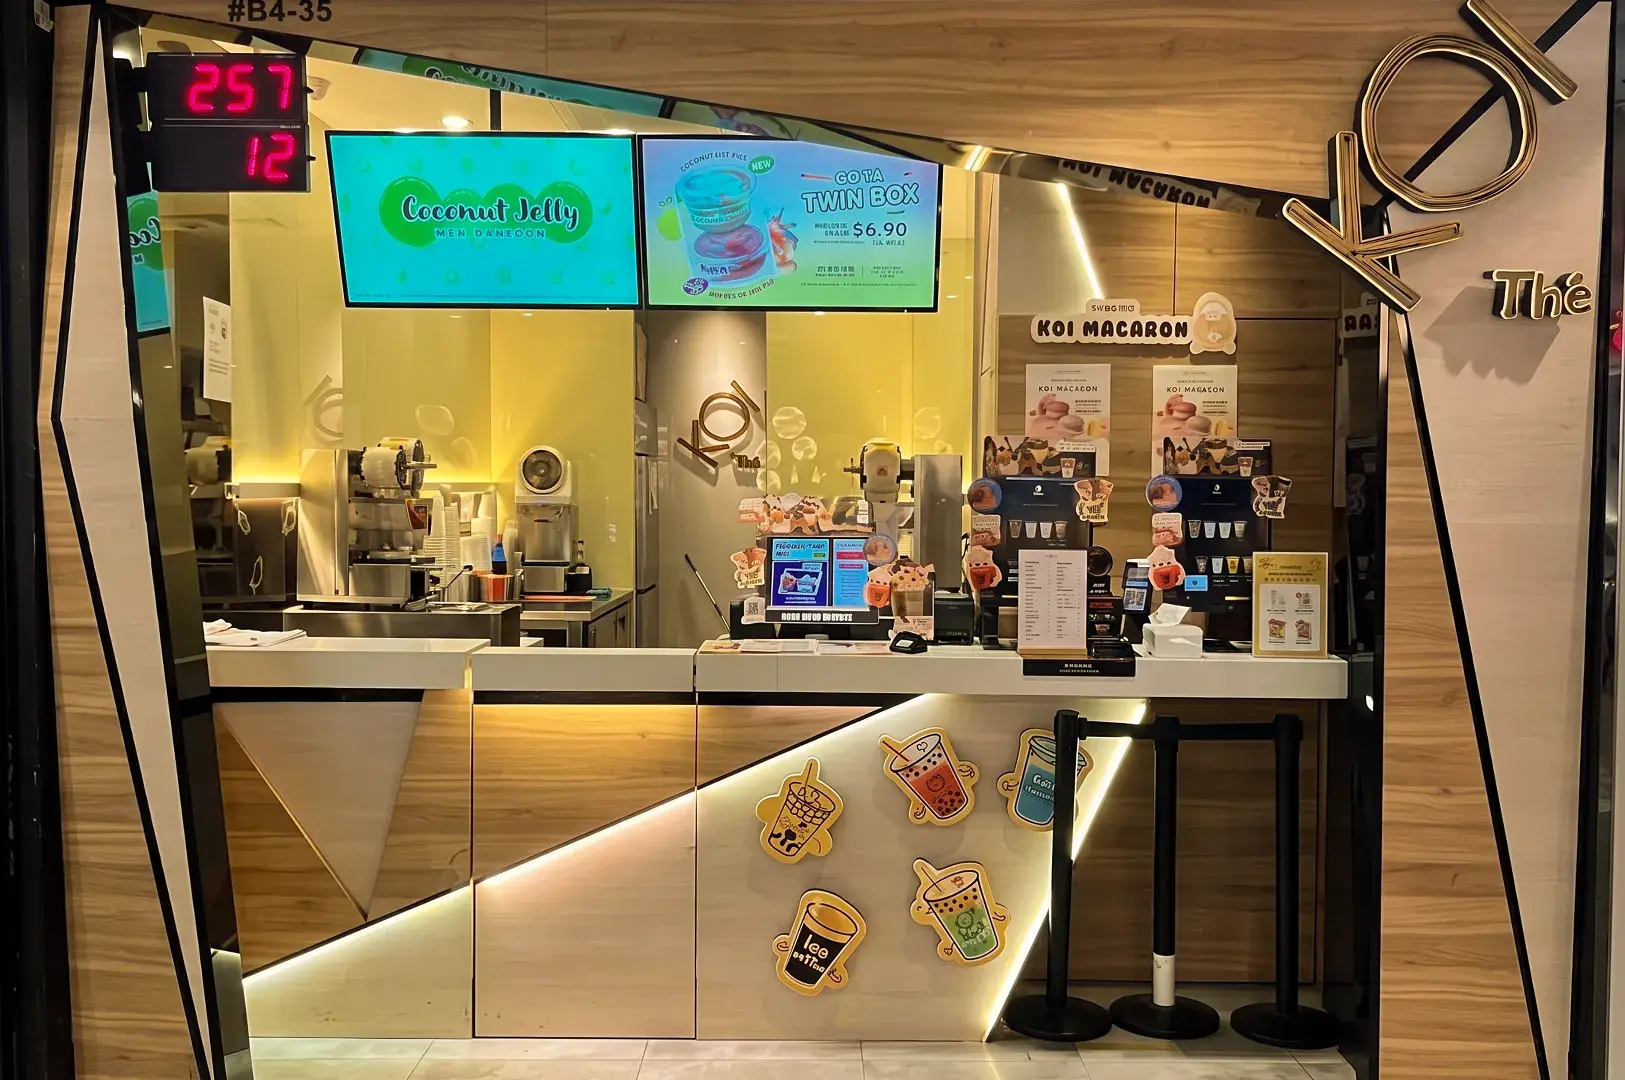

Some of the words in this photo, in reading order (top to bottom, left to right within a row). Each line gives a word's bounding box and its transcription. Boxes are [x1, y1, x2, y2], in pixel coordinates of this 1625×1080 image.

[228, 0, 332, 22] #B4-35
[188, 63, 294, 113] 257
[247, 132, 297, 183] 12
[680, 152, 714, 172] COCONUT
[751, 159, 771, 171] NEW
[801, 188, 865, 214] TWIN
[870, 182, 920, 208] BOX
[402, 195, 508, 223] Coconut
[514, 197, 579, 232] Jelly
[435, 229, 466, 239] MEN
[853, 221, 907, 238] $6.90
[1490, 270, 1593, 320] Thé
[1037, 319, 1075, 337] KOI
[1082, 320, 1188, 338] MACARON
